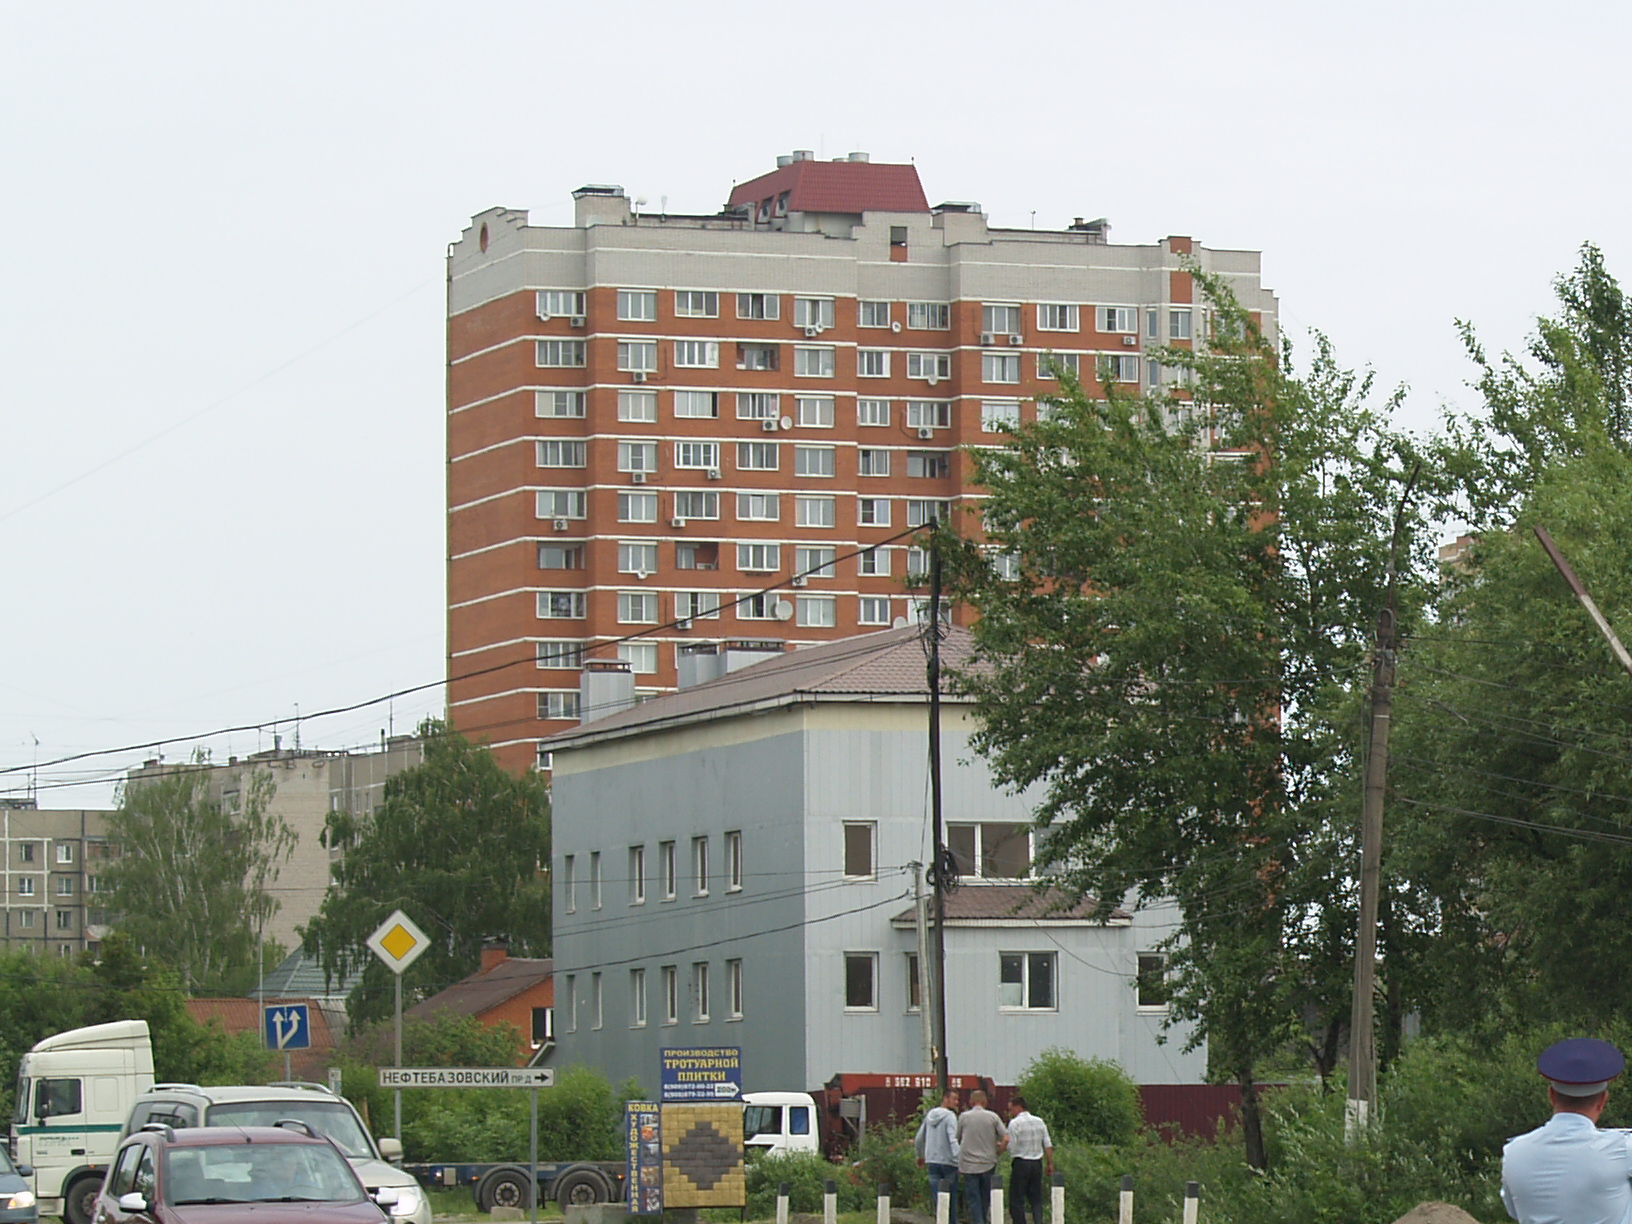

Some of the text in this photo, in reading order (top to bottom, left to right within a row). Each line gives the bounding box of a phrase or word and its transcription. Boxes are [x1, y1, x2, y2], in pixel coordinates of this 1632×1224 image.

[664, 1049, 738, 1057] ПРОИЗВОДСТВО
[664, 1057, 739, 1069] ТРОТУАРНОЙ
[383, 1071, 509, 1083] НЕФТЕБАЗОВСКИЙ
[678, 1071, 726, 1082] ПЛИТКИ
[628, 1104, 659, 1112] КОВКА
[629, 1114, 639, 1213] ХУДОЖЕСТВЕННАЯ
